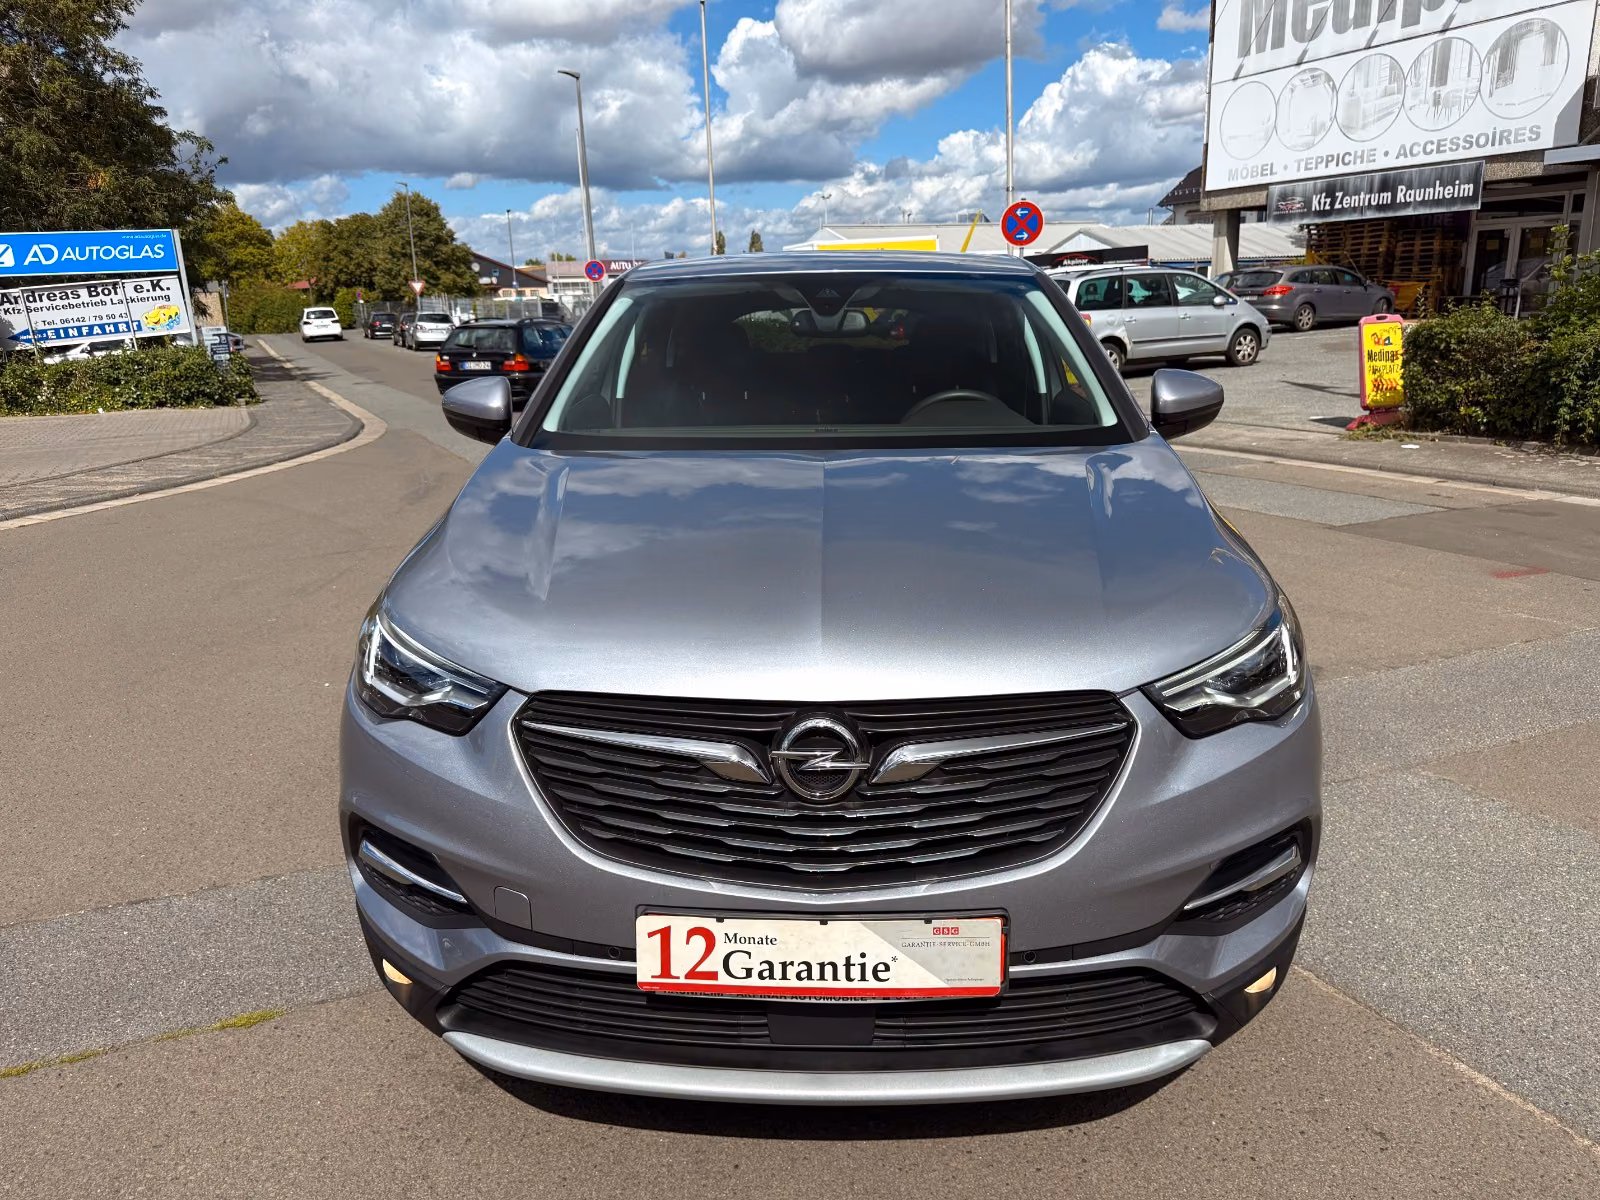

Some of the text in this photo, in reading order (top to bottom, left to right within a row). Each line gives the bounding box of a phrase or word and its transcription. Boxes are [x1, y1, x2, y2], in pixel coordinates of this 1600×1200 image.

[1228, 162, 1278, 181] MÖBEL
[1295, 148, 1377, 173] TEPPICHE
[1311, 180, 1474, 212] Kfz Zentrum Raunheim
[23, 244, 165, 266] AD AUTOGLAS
[610, 261, 632, 270] AUTO
[0, 289, 80, 306] Andreas
[133, 279, 171, 293] e.K.
[110, 294, 171, 306] Lackierung
[41, 319, 58, 327] Tel.
[60, 316, 86, 325] 06142
[93, 314, 103, 322] 79
[106, 313, 116, 321] 50
[47, 322, 139, 339] EINFAHRT
[723, 932, 777, 945] Monate
[933, 927, 959, 935] GSG
[647, 925, 718, 981] 12
